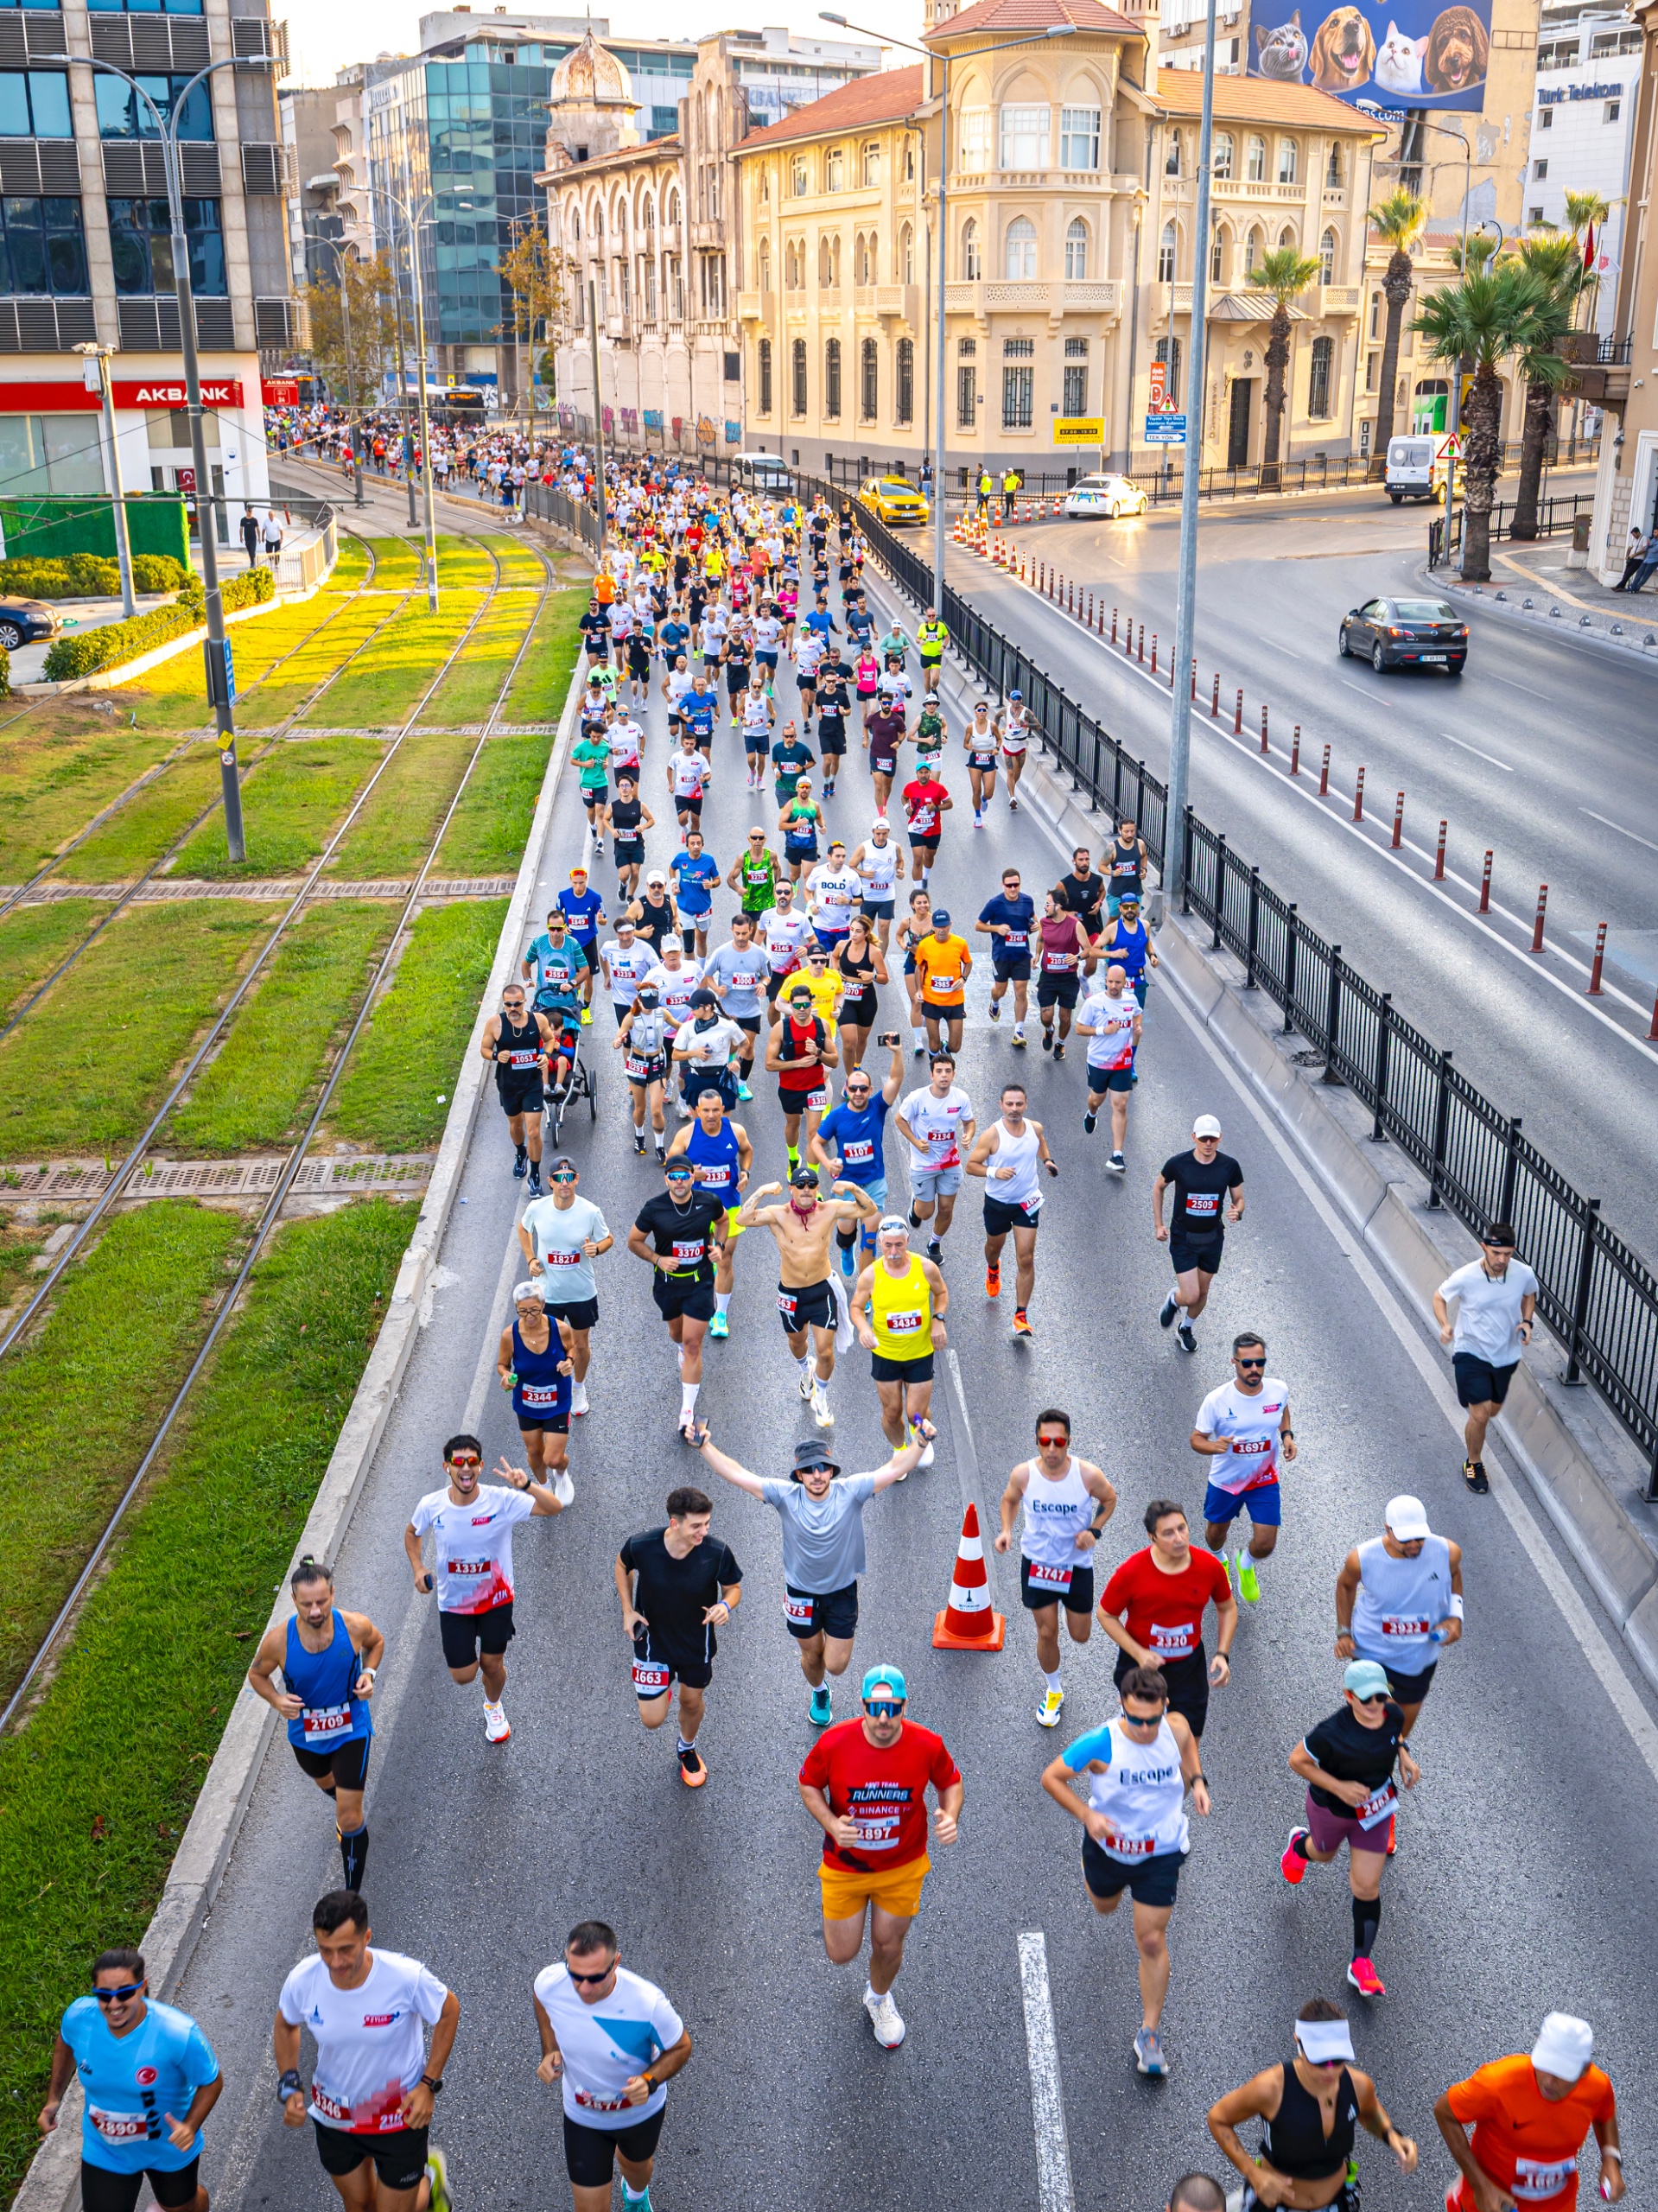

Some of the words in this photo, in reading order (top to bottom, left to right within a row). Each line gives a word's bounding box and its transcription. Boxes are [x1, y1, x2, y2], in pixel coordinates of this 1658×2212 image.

[1538, 88, 1565, 105] Türk
[1568, 82, 1623, 100] Telekom
[136, 387, 230, 402] AKBNK
[821, 881, 846, 890] BOLD
[515, 1055, 533, 1064] 1053
[848, 1147, 868, 1157] 1107
[706, 1172, 727, 1181] 2139
[1191, 1200, 1214, 1209] 2509
[677, 1247, 701, 1257] 3370
[552, 1255, 575, 1264] 1827
[892, 1317, 917, 1328] 3434
[527, 1392, 552, 1402] 2344
[1238, 1442, 1266, 1453] 1697
[1032, 1499, 1078, 1516] Escape
[455, 1563, 484, 1573] 1337
[1035, 1565, 1065, 1581] 2747
[635, 1669, 662, 1684] 1663
[311, 1715, 344, 1731] 2709
[1120, 1765, 1173, 1786] Escape
[852, 1789, 909, 1802] RUNNERS
[859, 1805, 900, 1815] BINANCE
[857, 1826, 892, 1840] 2897
[314, 2090, 341, 2120] 3346
[96, 2117, 138, 2136] 2890
